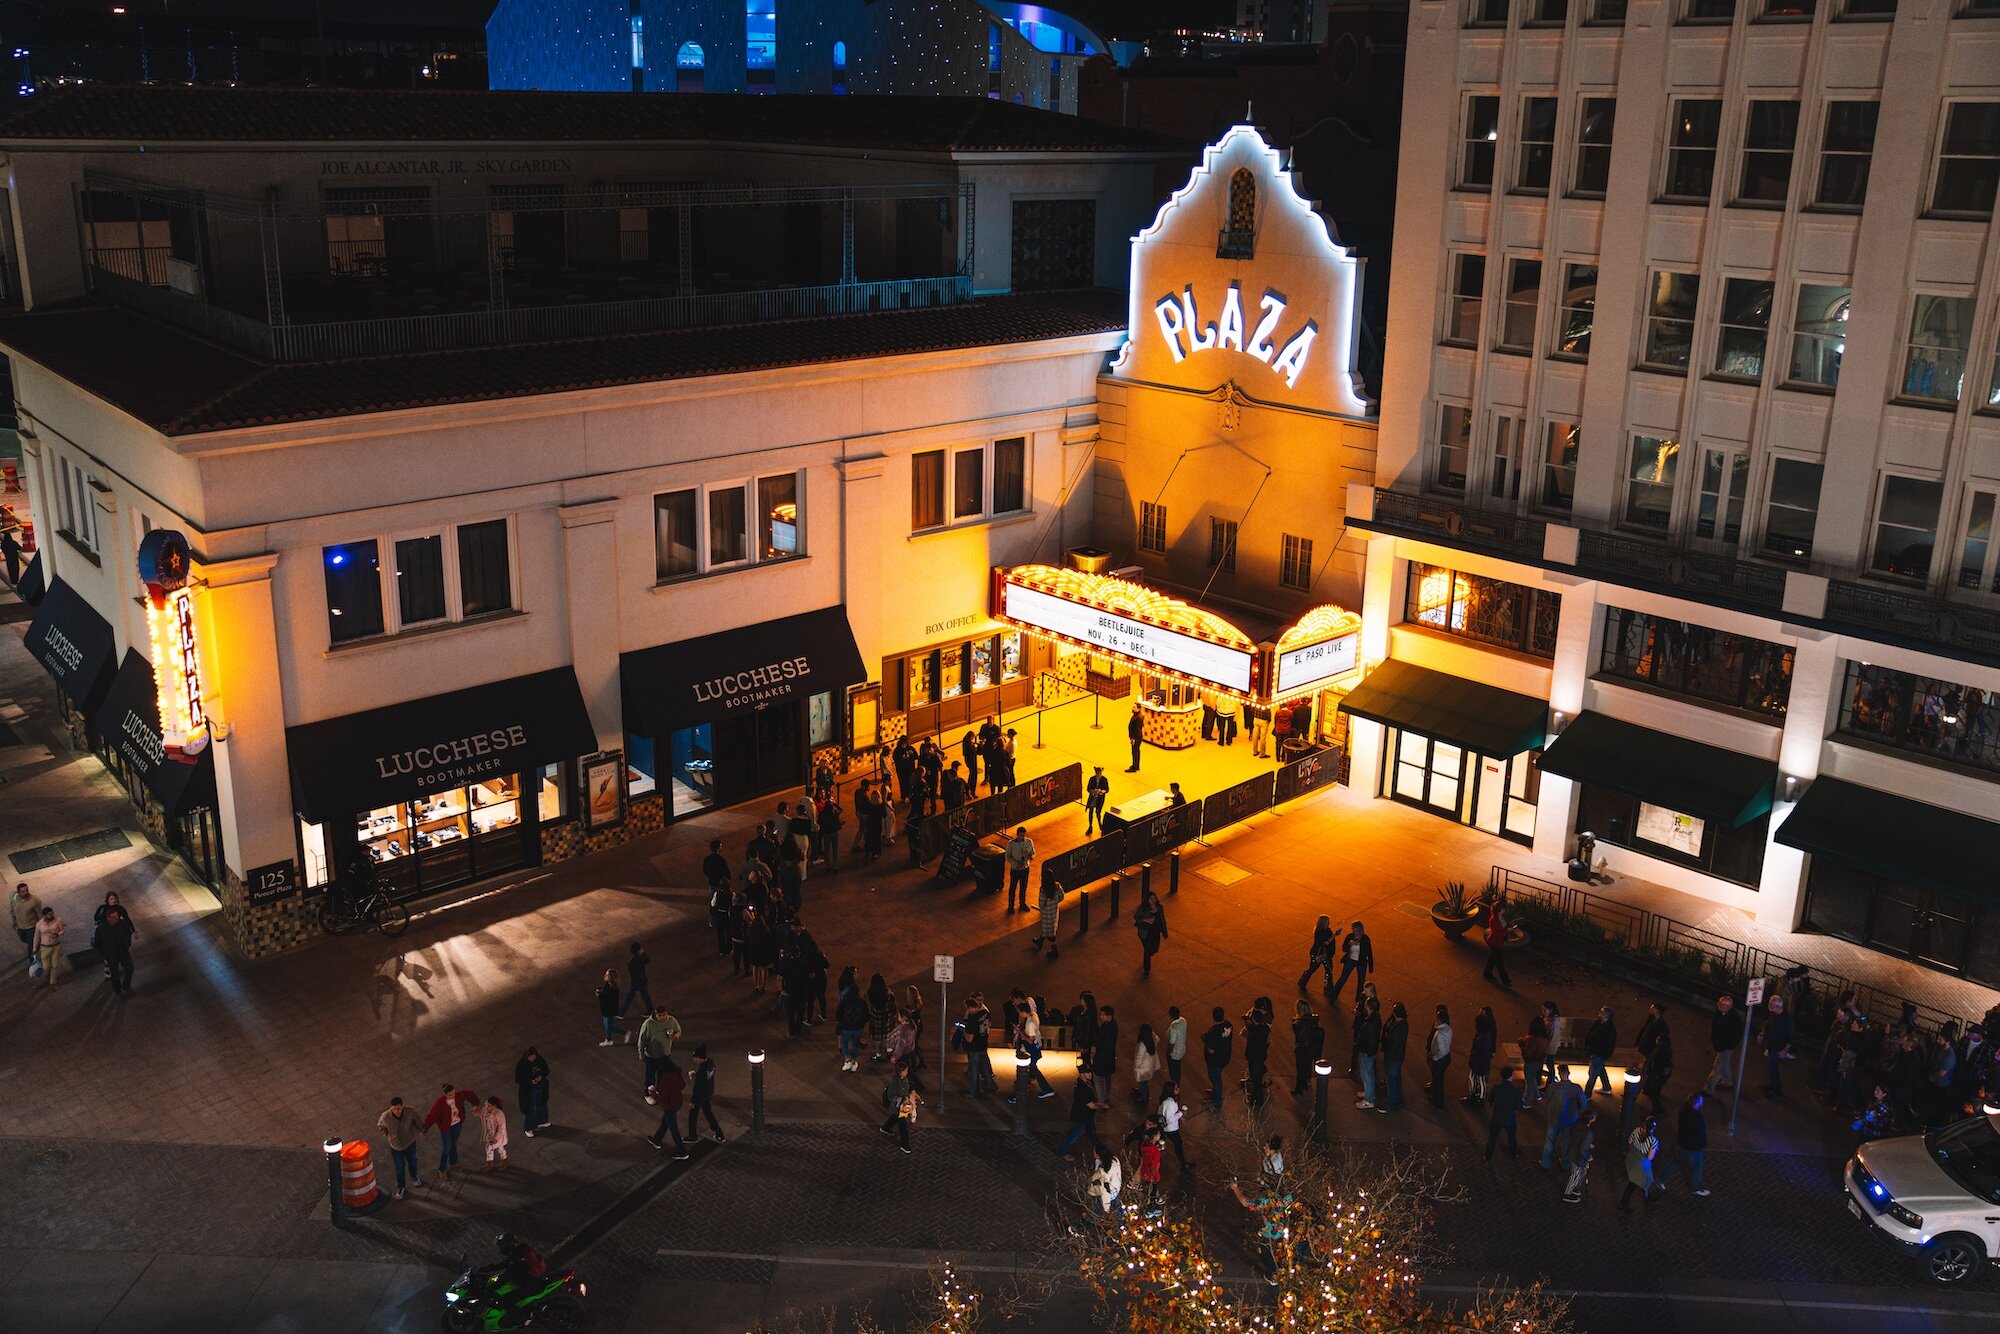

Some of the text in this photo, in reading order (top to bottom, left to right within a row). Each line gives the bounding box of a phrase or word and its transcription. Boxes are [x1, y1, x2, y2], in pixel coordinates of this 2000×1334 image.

[320, 161, 350, 175] JOE
[354, 160, 444, 175] ALCANTAR,
[476, 160, 506, 173] SKY
[510, 159, 572, 173] GARDEN
[1154, 279, 1319, 389] PLAZA
[925, 614, 977, 635] BOX OFFICE
[1098, 616, 1144, 639] BEETLEJUICE
[45, 624, 83, 671] LUCCHESE
[1088, 628, 1104, 641] NOV.
[1108, 635, 1118, 646] 26
[1130, 642, 1148, 655] DEC.
[1294, 641, 1342, 665] EL PASO LIVE
[45, 653, 66, 678] BOOTMAKER
[178, 596, 202, 726] PLAZA
[692, 656, 811, 702] LUCCHESE
[725, 684, 792, 709] BOOTMAKER
[121, 709, 165, 767] LUCCHESE
[122, 741, 149, 774] BOOTMAKER
[375, 725, 527, 779] LUCCHESE
[417, 758, 501, 787] BOOTMAKER
[253, 885, 292, 899] Pioneer Plaza
[260, 870, 285, 889] 125
